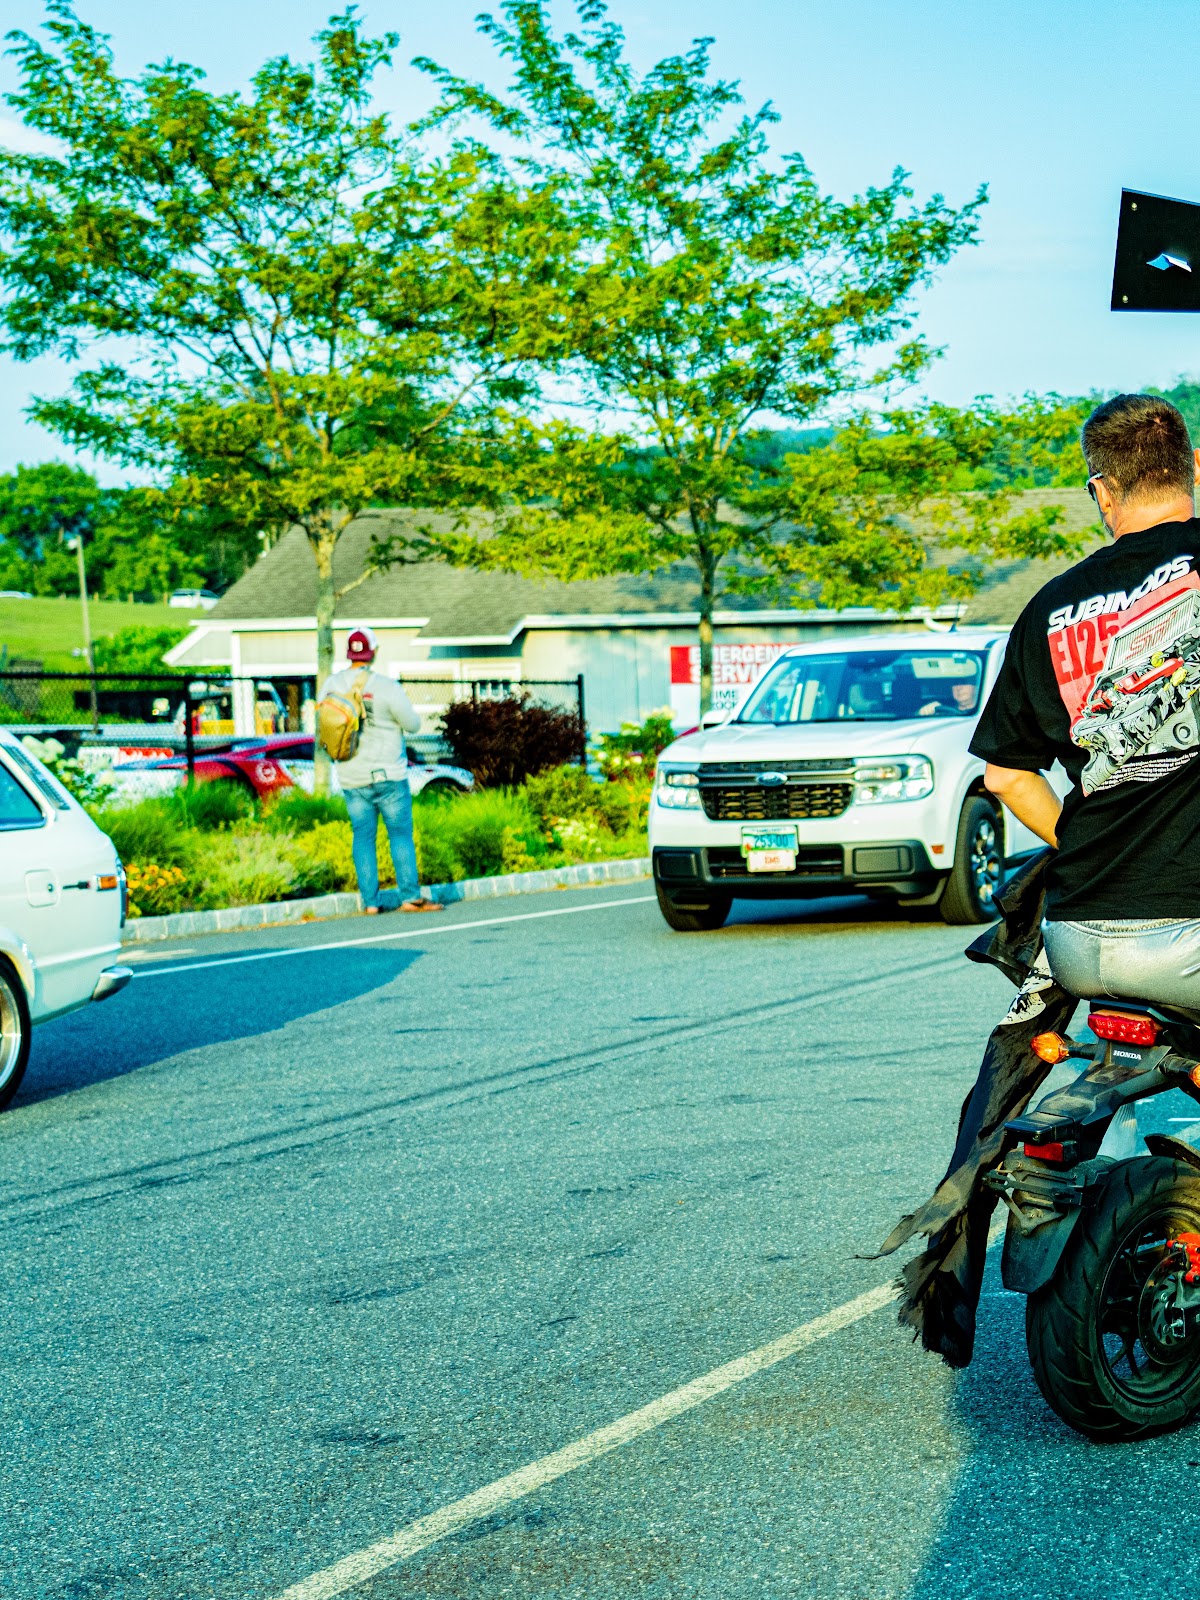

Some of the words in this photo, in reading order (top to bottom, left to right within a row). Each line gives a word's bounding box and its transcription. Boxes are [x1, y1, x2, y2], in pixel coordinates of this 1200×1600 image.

[1047, 555, 1194, 635] SUBIMODS
[1047, 612, 1120, 685] EJ25
[1113, 1050, 1142, 1061] HONDA
